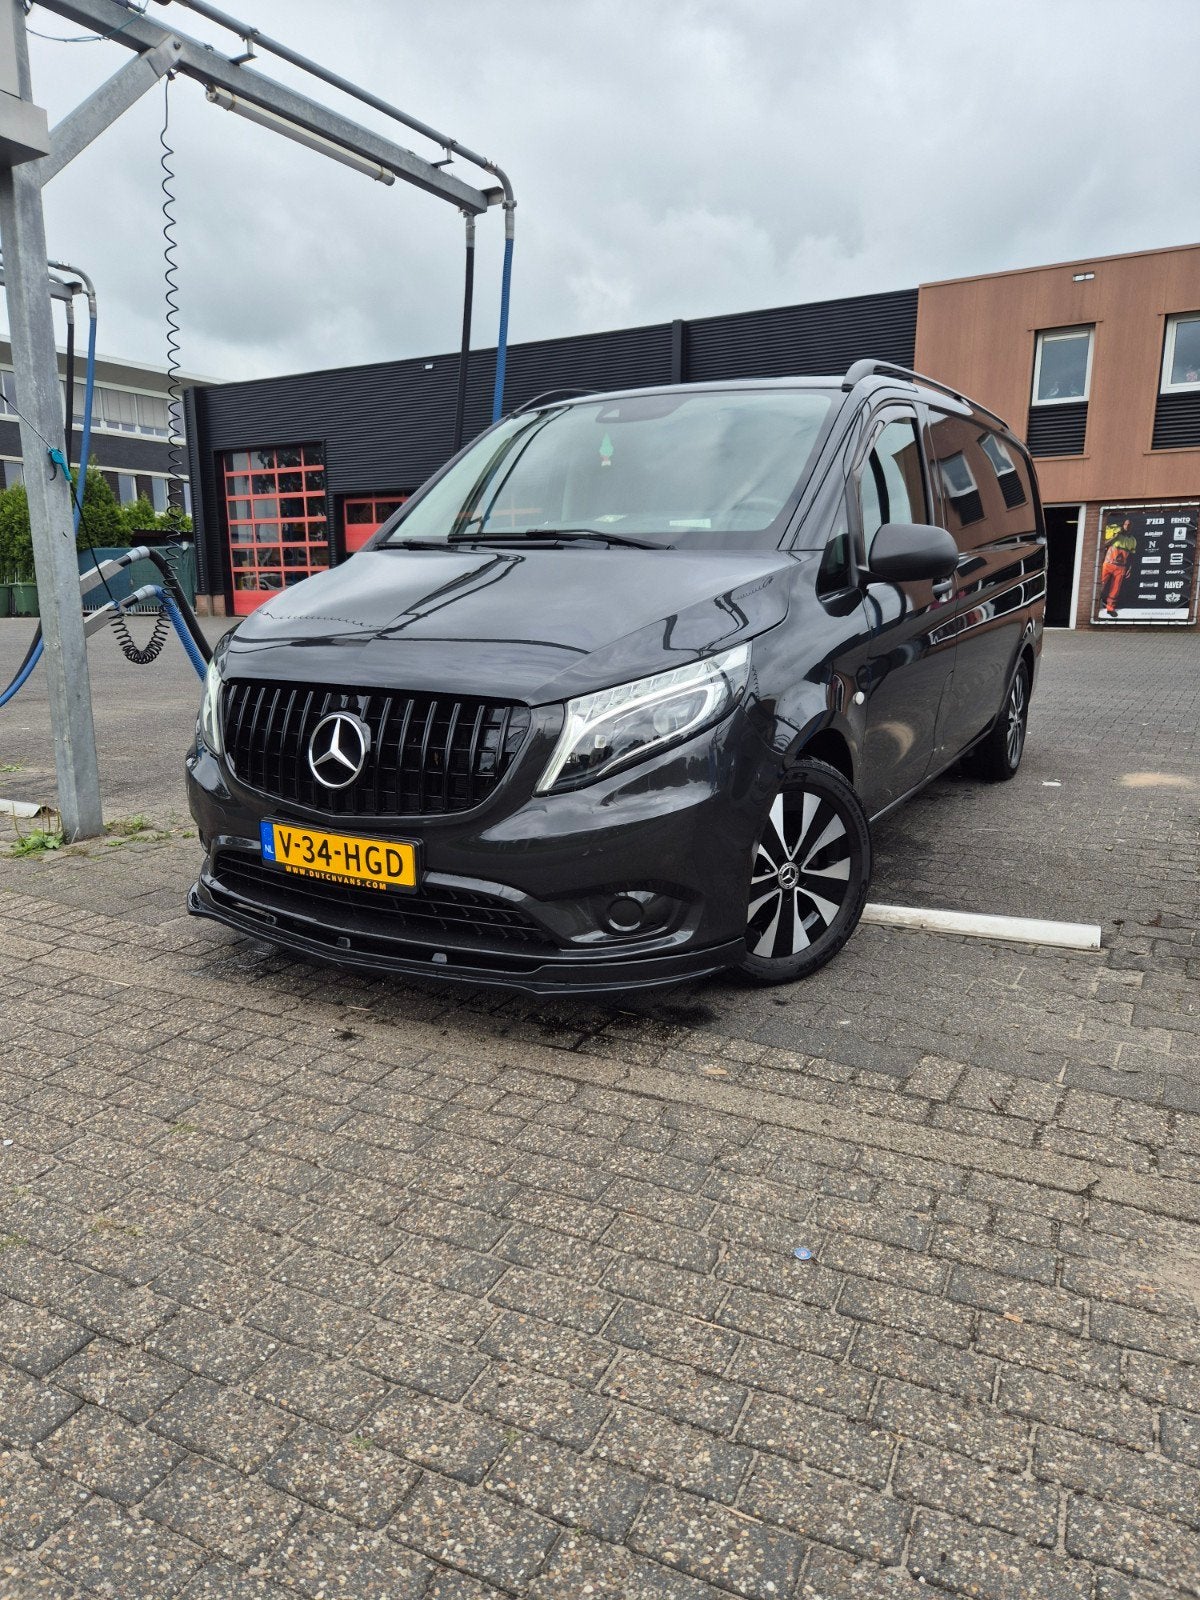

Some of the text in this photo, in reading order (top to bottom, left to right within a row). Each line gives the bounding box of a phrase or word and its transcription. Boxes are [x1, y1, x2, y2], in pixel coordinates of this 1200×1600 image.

[1164, 581, 1184, 589] HAVEP
[264, 844, 274, 854] NL
[278, 830, 404, 878] V-34-HGD
[285, 865, 388, 890] WWW.DUTCHVANS.COM
